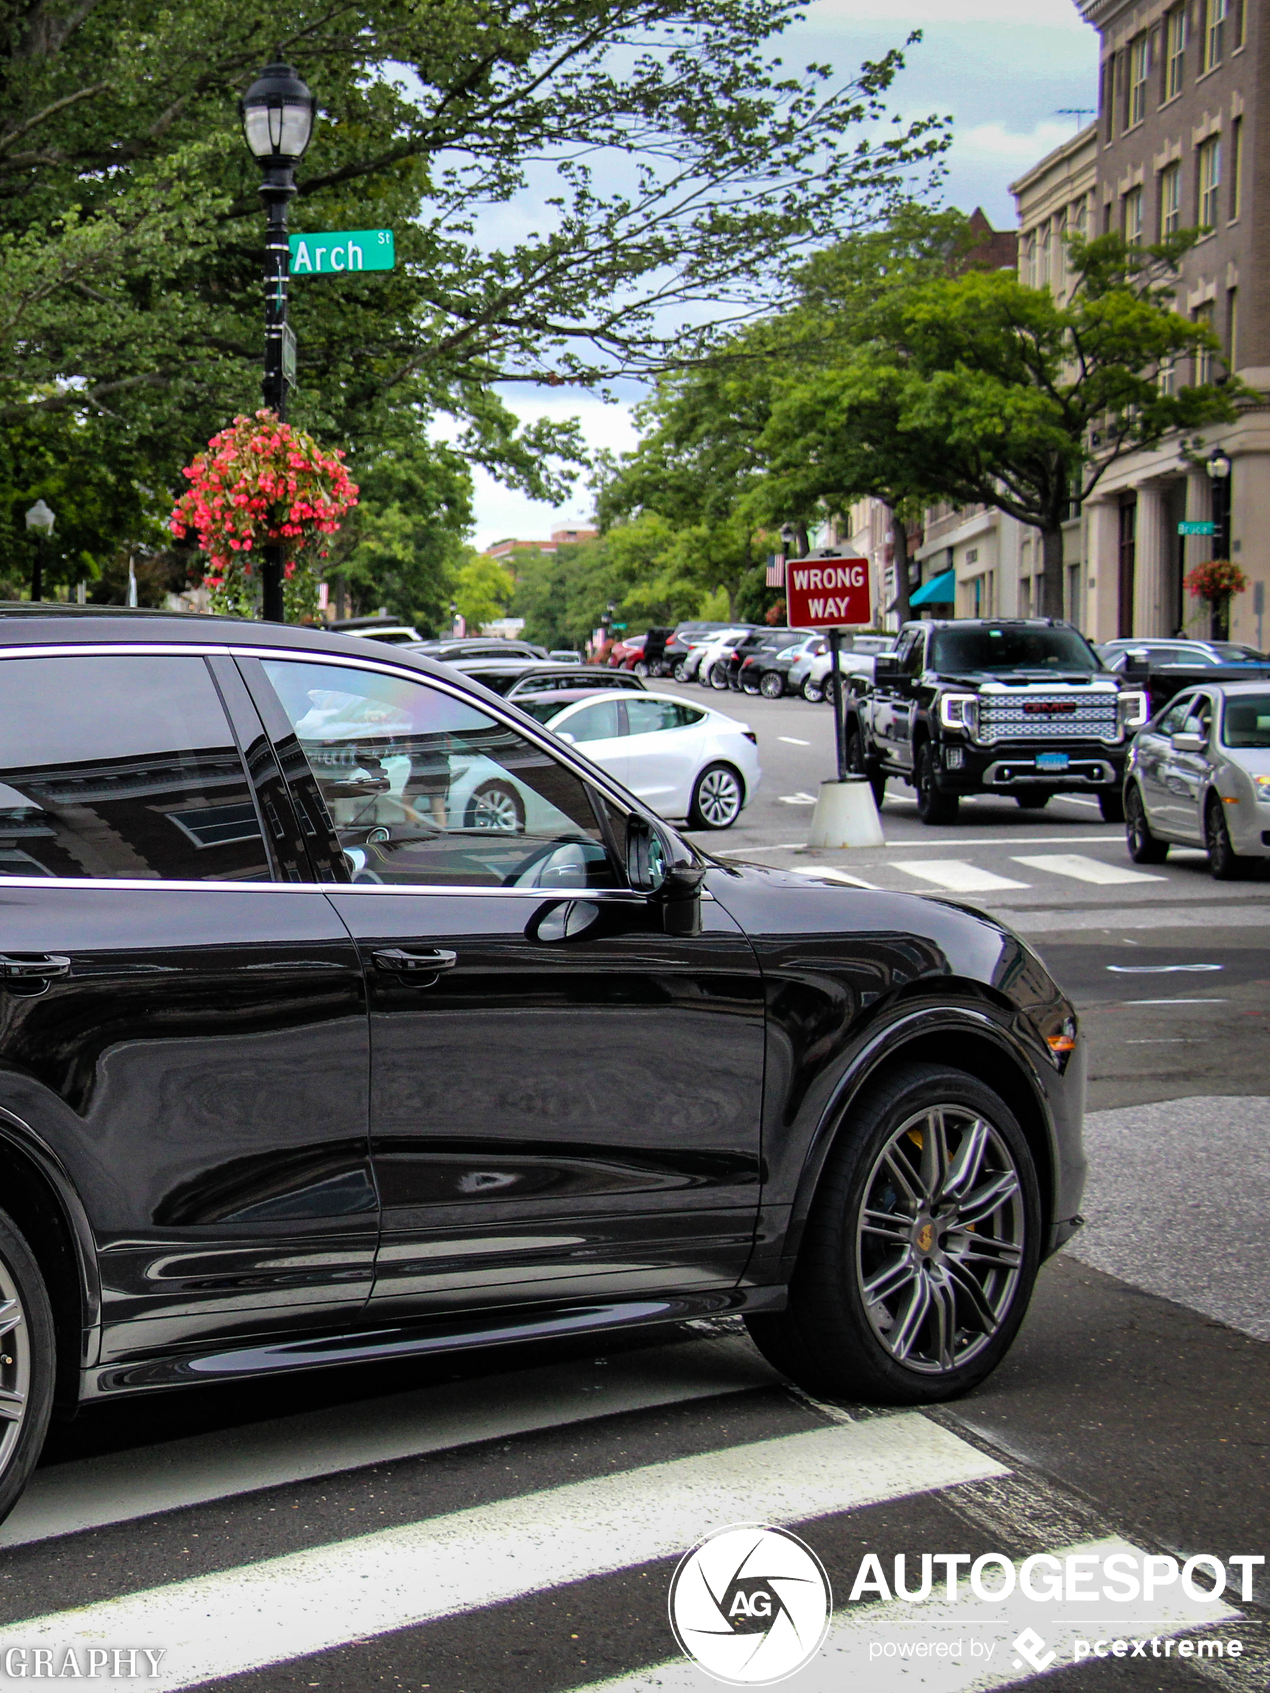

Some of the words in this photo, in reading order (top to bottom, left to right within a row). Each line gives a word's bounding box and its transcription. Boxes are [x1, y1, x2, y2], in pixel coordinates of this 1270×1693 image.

[293, 240, 363, 272] Arch
[377, 232, 390, 244] St
[793, 566, 865, 591] WRONG
[808, 596, 851, 619] WAY
[1024, 702, 1076, 713] GMC
